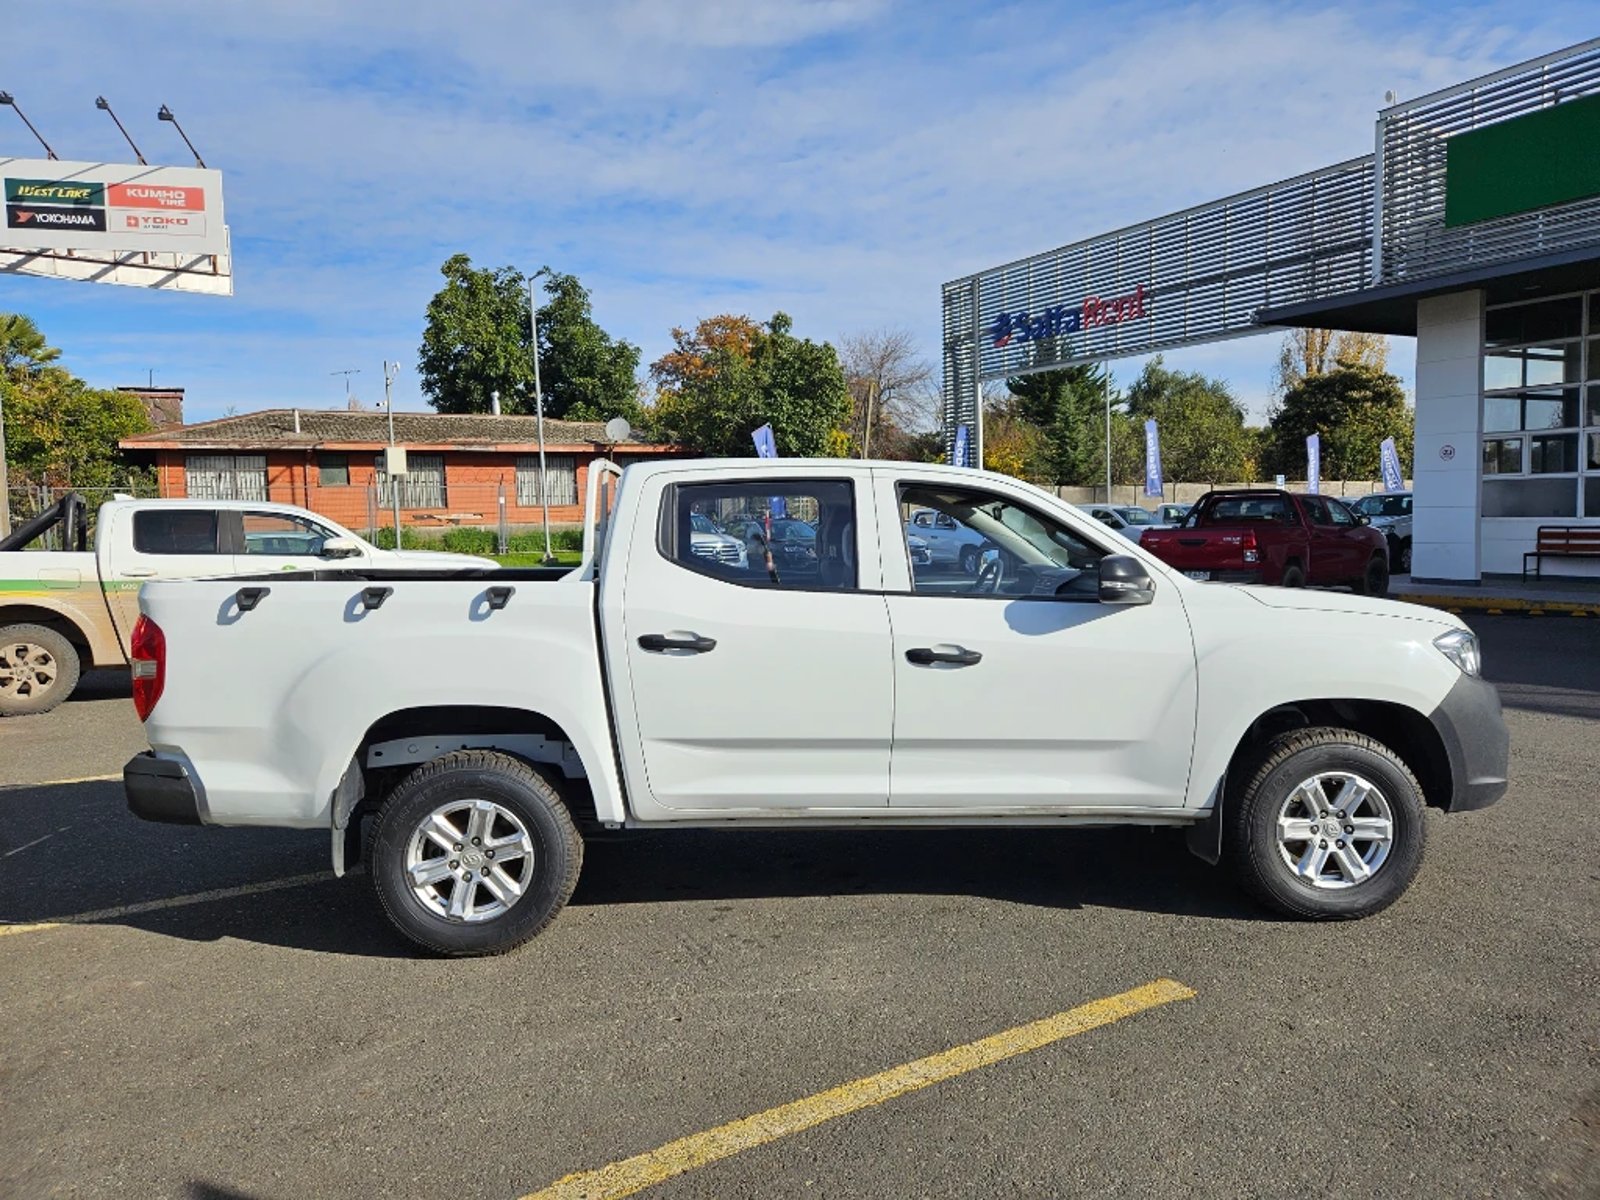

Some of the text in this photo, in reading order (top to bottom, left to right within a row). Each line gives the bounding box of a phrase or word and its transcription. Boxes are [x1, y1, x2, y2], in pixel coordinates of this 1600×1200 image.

[126, 188, 186, 199] KUMHO
[158, 198, 186, 207] TIRE
[35, 213, 96, 225] YOKOHAMA
[142, 216, 188, 225] YOKO
